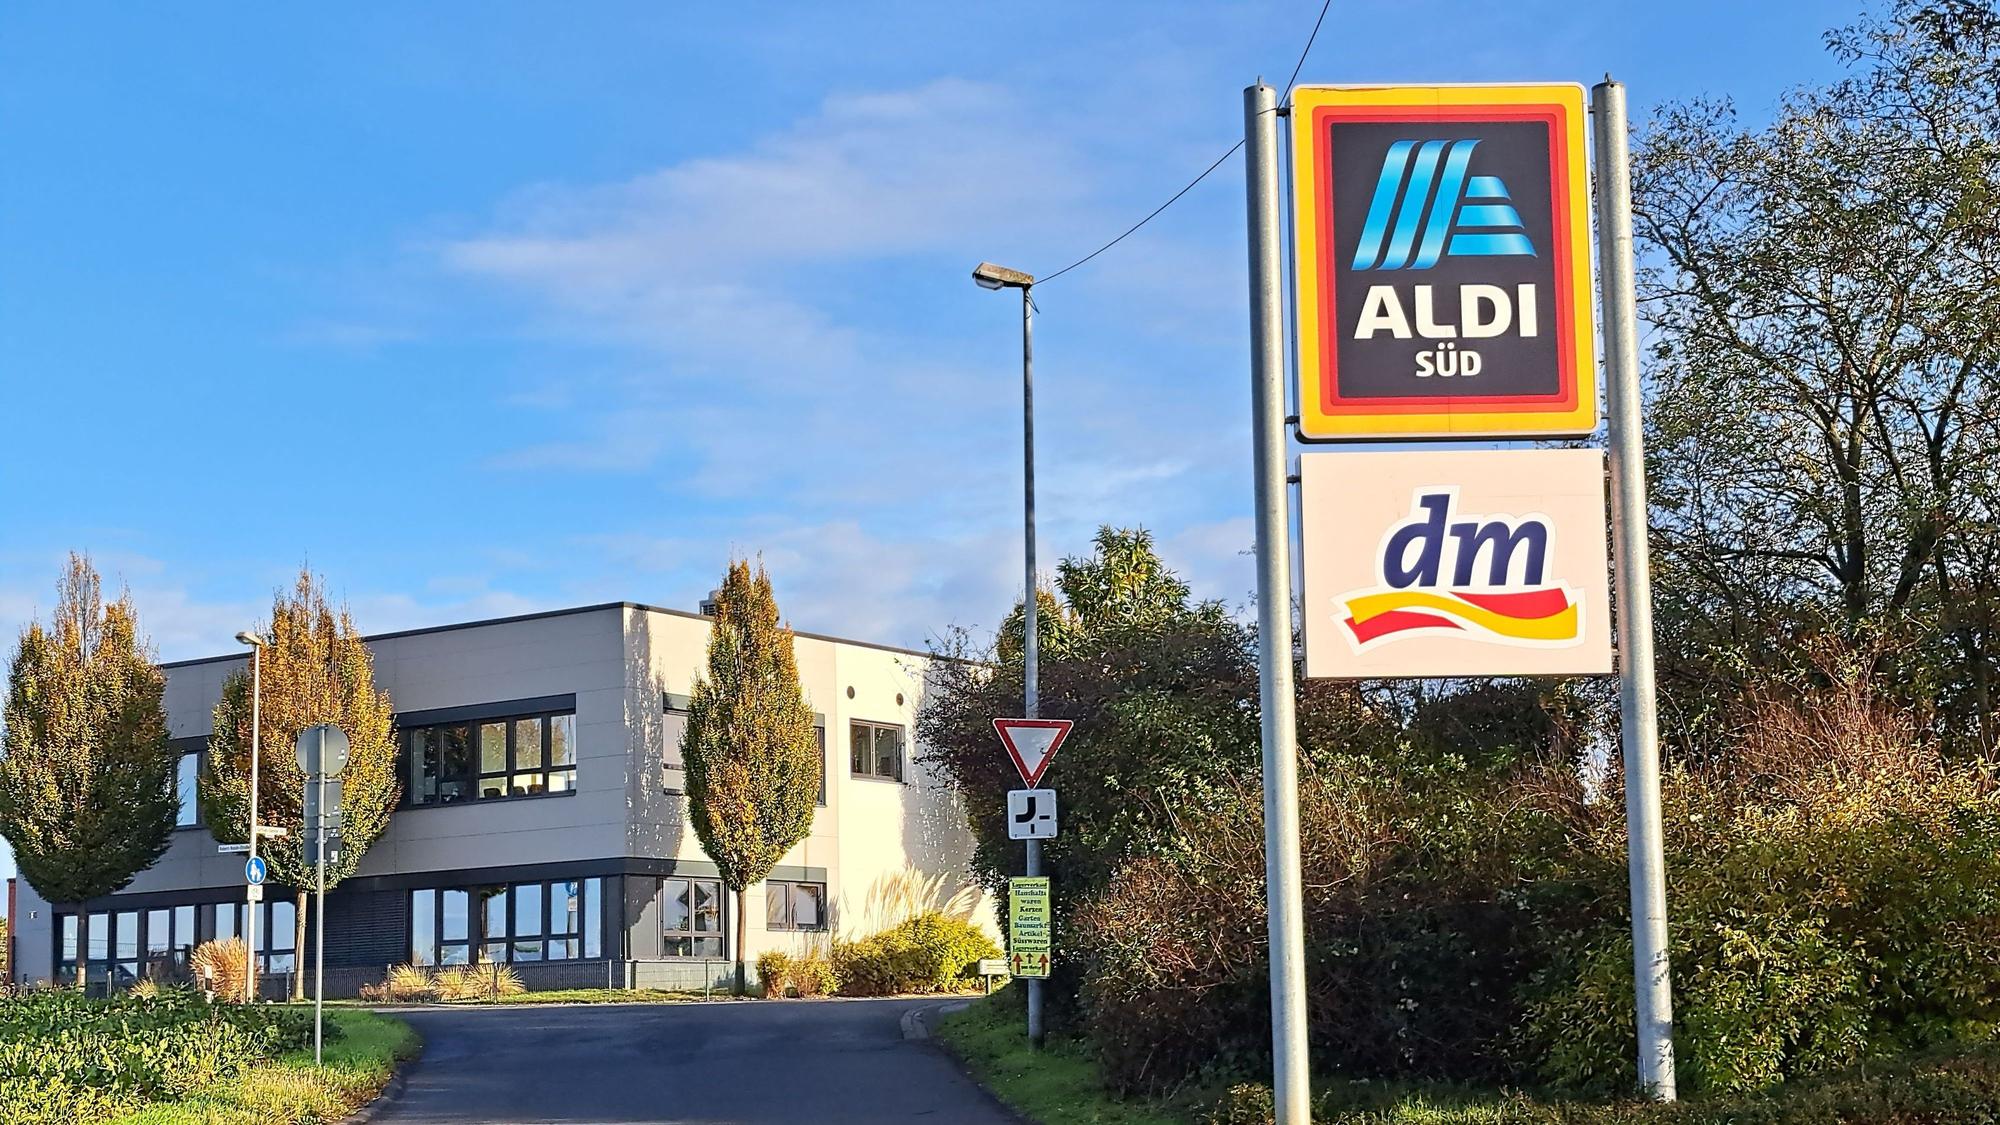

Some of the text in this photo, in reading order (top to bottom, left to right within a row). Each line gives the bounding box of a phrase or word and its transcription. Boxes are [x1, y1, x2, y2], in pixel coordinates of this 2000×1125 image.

[1353, 283, 1538, 339] ALDI
[1415, 342, 1482, 377] SÜD
[1383, 493, 1548, 589] dm
